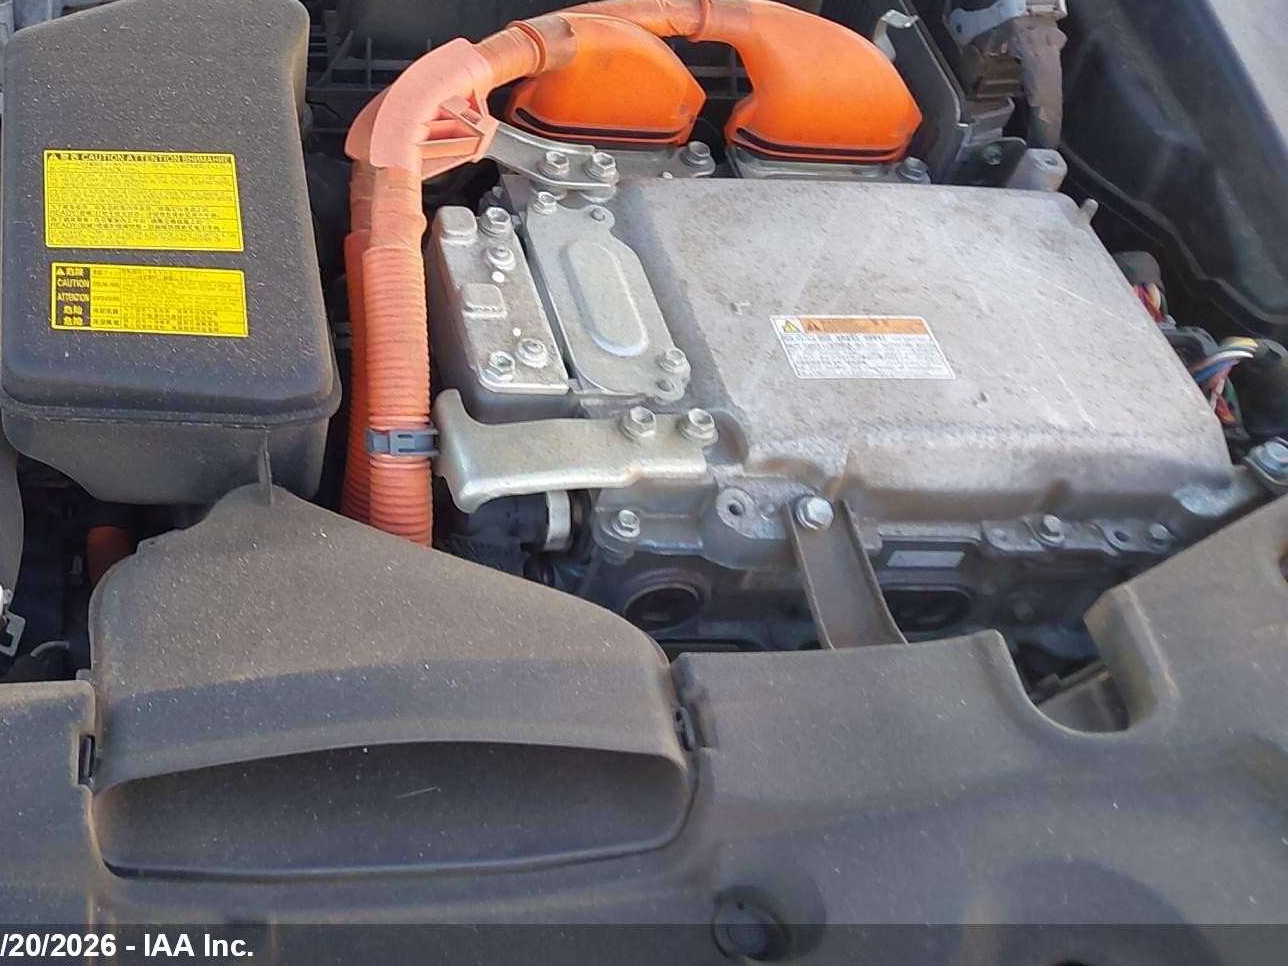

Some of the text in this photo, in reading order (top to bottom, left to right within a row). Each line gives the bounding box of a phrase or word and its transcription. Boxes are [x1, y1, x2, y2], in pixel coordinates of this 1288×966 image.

[81, 153, 123, 163] CAUTION
[125, 154, 176, 163] ATTENTION
[57, 278, 89, 288] CAUTION
[57, 292, 89, 302] ATTENTION
